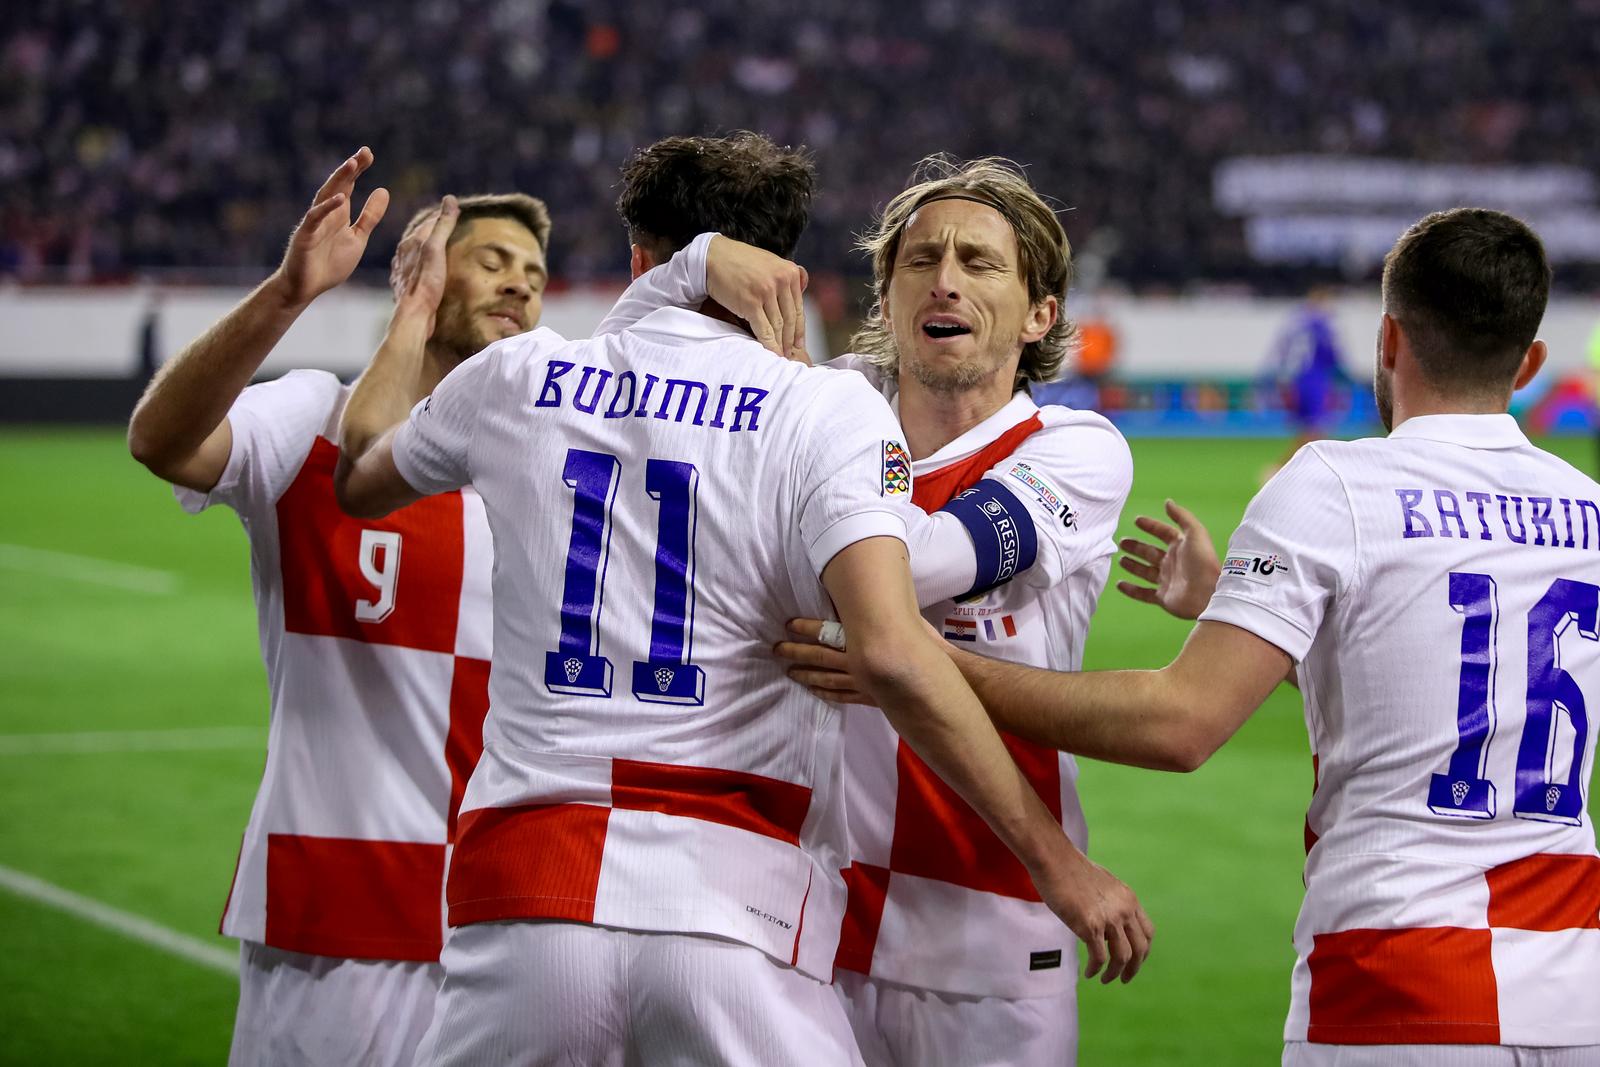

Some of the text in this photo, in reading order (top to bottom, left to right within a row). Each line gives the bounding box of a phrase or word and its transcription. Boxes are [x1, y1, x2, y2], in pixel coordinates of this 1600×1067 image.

[534, 360, 769, 433] BUDIMIR
[1010, 467, 1062, 509] FOUNDATION
[355, 529, 402, 624] 9
[544, 448, 706, 707] 11
[1427, 572, 1600, 827] 16
